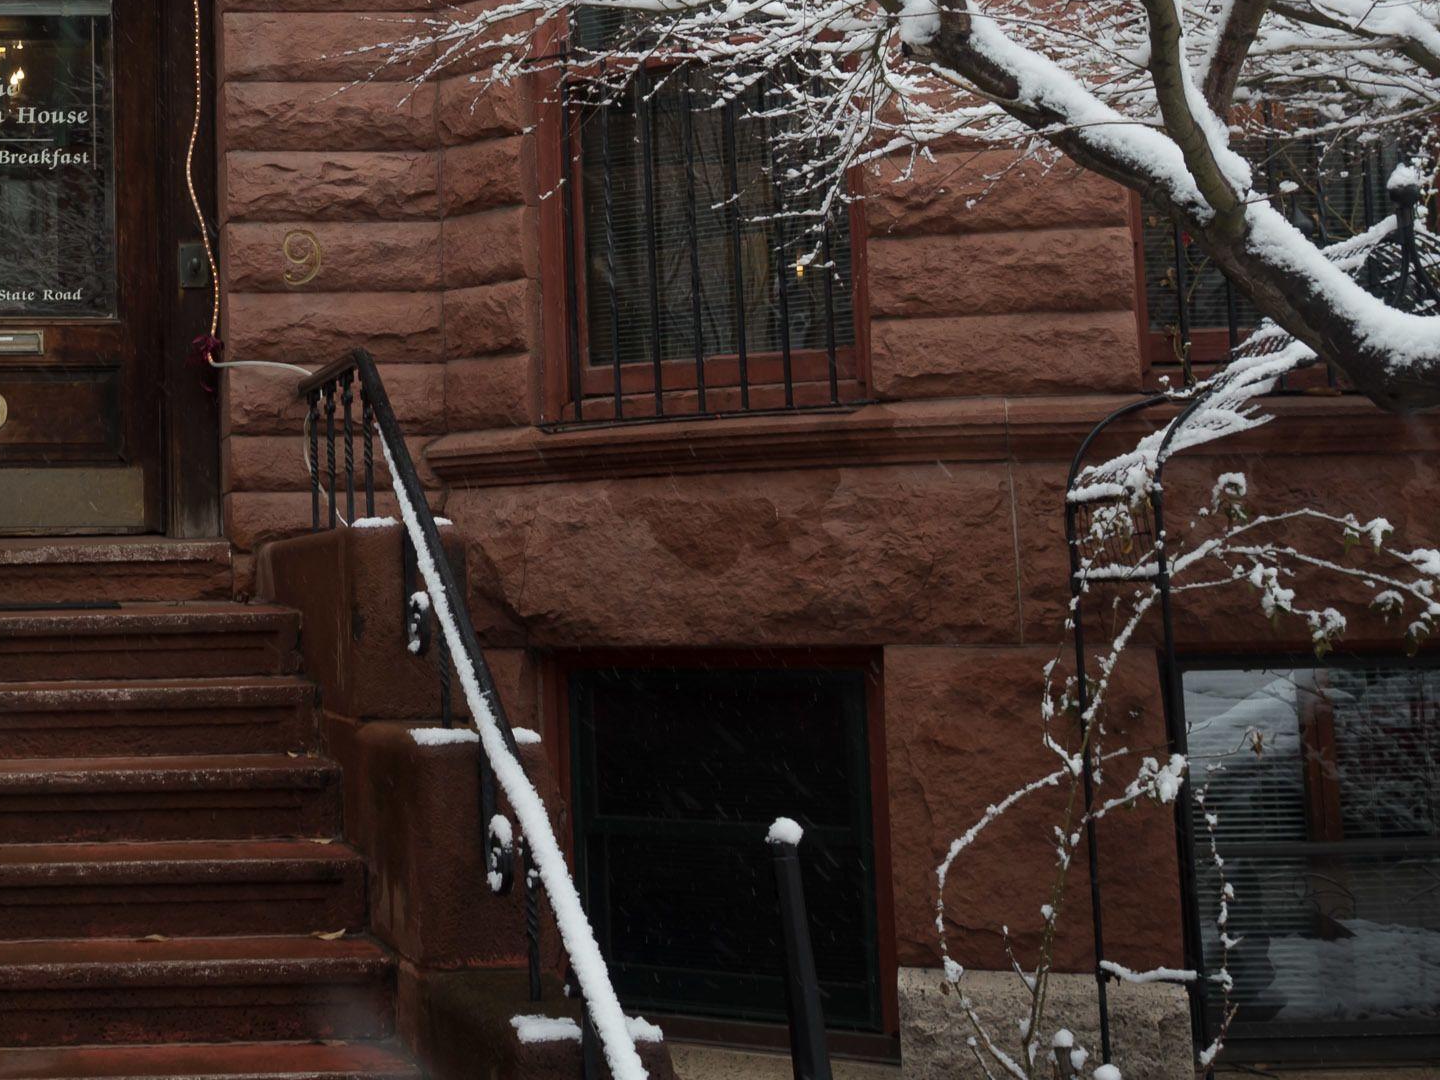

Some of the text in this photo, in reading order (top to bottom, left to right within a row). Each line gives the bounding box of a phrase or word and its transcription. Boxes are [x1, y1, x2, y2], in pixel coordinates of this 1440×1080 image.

[15, 106, 89, 125] House
[283, 229, 321, 286] 9
[42, 288, 84, 301] Road
